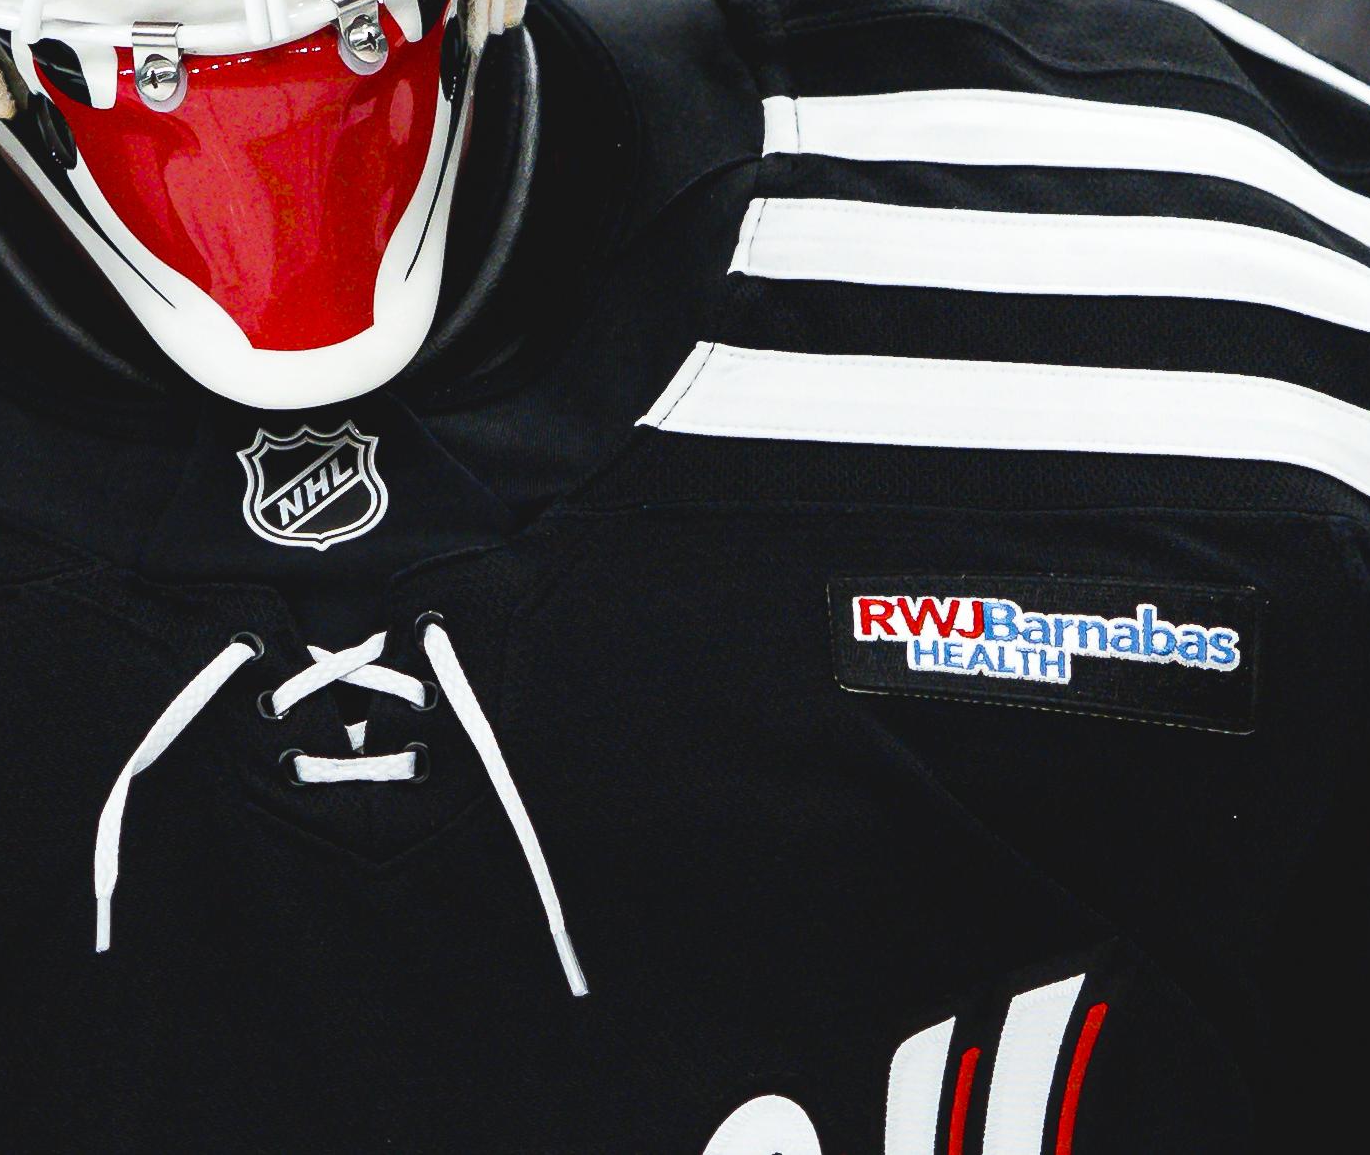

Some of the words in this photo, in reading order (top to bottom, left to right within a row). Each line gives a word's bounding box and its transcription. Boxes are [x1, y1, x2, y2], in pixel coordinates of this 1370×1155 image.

[277, 457, 354, 527] NHL
[857, 596, 1239, 666] RWJBarnabas
[913, 640, 1068, 679] HEALTH
